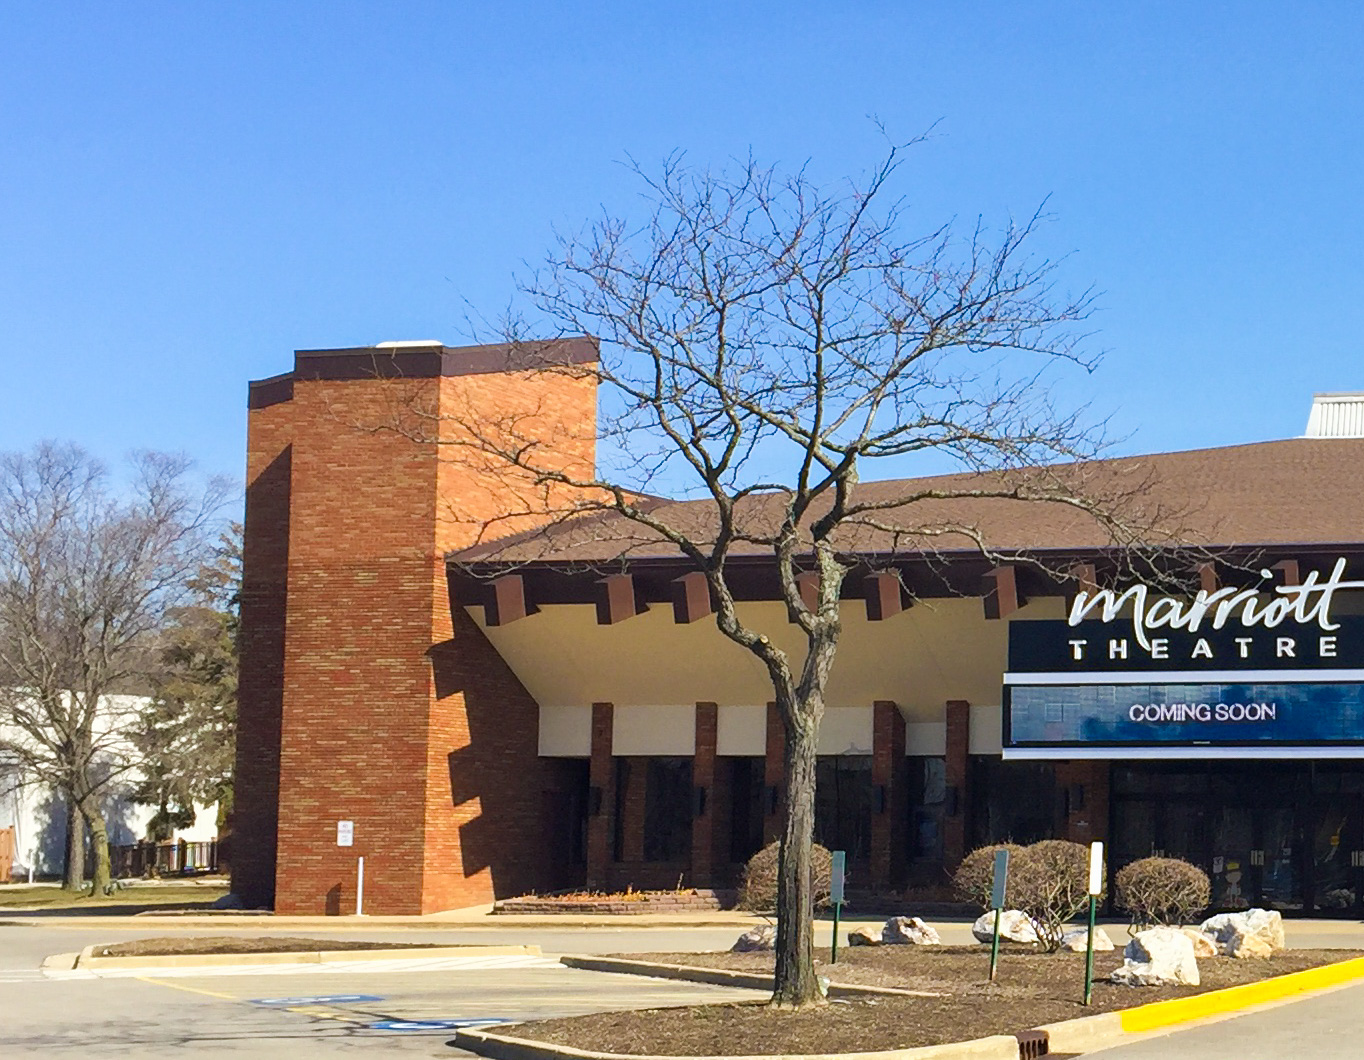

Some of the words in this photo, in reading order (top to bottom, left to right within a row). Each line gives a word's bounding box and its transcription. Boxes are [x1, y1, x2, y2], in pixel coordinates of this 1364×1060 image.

[1067, 635, 1338, 660] THEATRE
[1128, 702, 1212, 722] COMING
[1214, 702, 1277, 721] SOON
